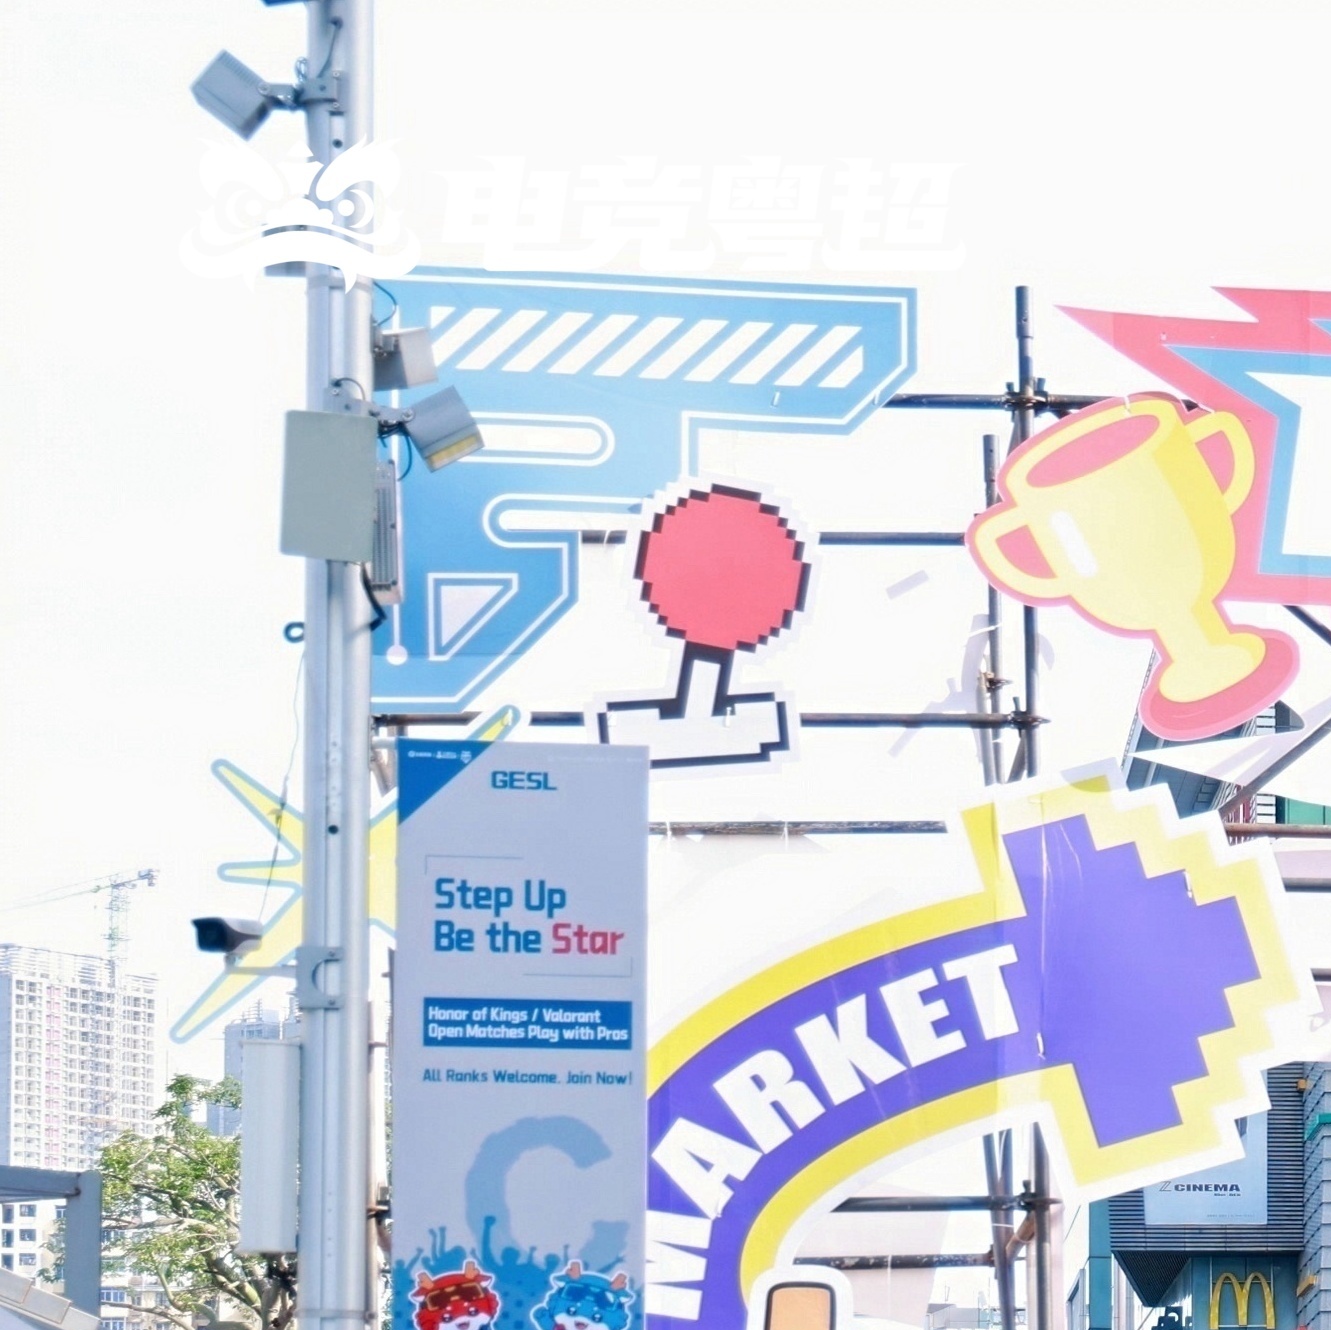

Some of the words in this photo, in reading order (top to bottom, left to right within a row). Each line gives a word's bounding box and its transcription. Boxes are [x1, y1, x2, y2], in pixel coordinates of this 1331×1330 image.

[491, 771, 558, 791] GESL
[434, 877, 513, 918] Step
[524, 879, 567, 919] Up
[434, 919, 475, 952] Be
[486, 922, 542, 953] the
[551, 923, 625, 955] Star
[428, 1006, 469, 1022] Honor
[472, 1006, 488, 1022] of
[490, 1007, 528, 1025] Kings
[543, 1008, 601, 1023] Valorant
[428, 1023, 464, 1041] Open
[466, 1024, 525, 1040] Matches
[528, 1025, 559, 1042] Play
[563, 1026, 594, 1041] with
[597, 1026, 629, 1041] Pros
[423, 1068, 442, 1083] All
[446, 1069, 489, 1084] Ranks
[566, 1071, 592, 1086] Join
[596, 1071, 633, 1086] Now!
[646, 943, 1020, 1321] MARKET
[1174, 1183, 1241, 1192] CINEMA
